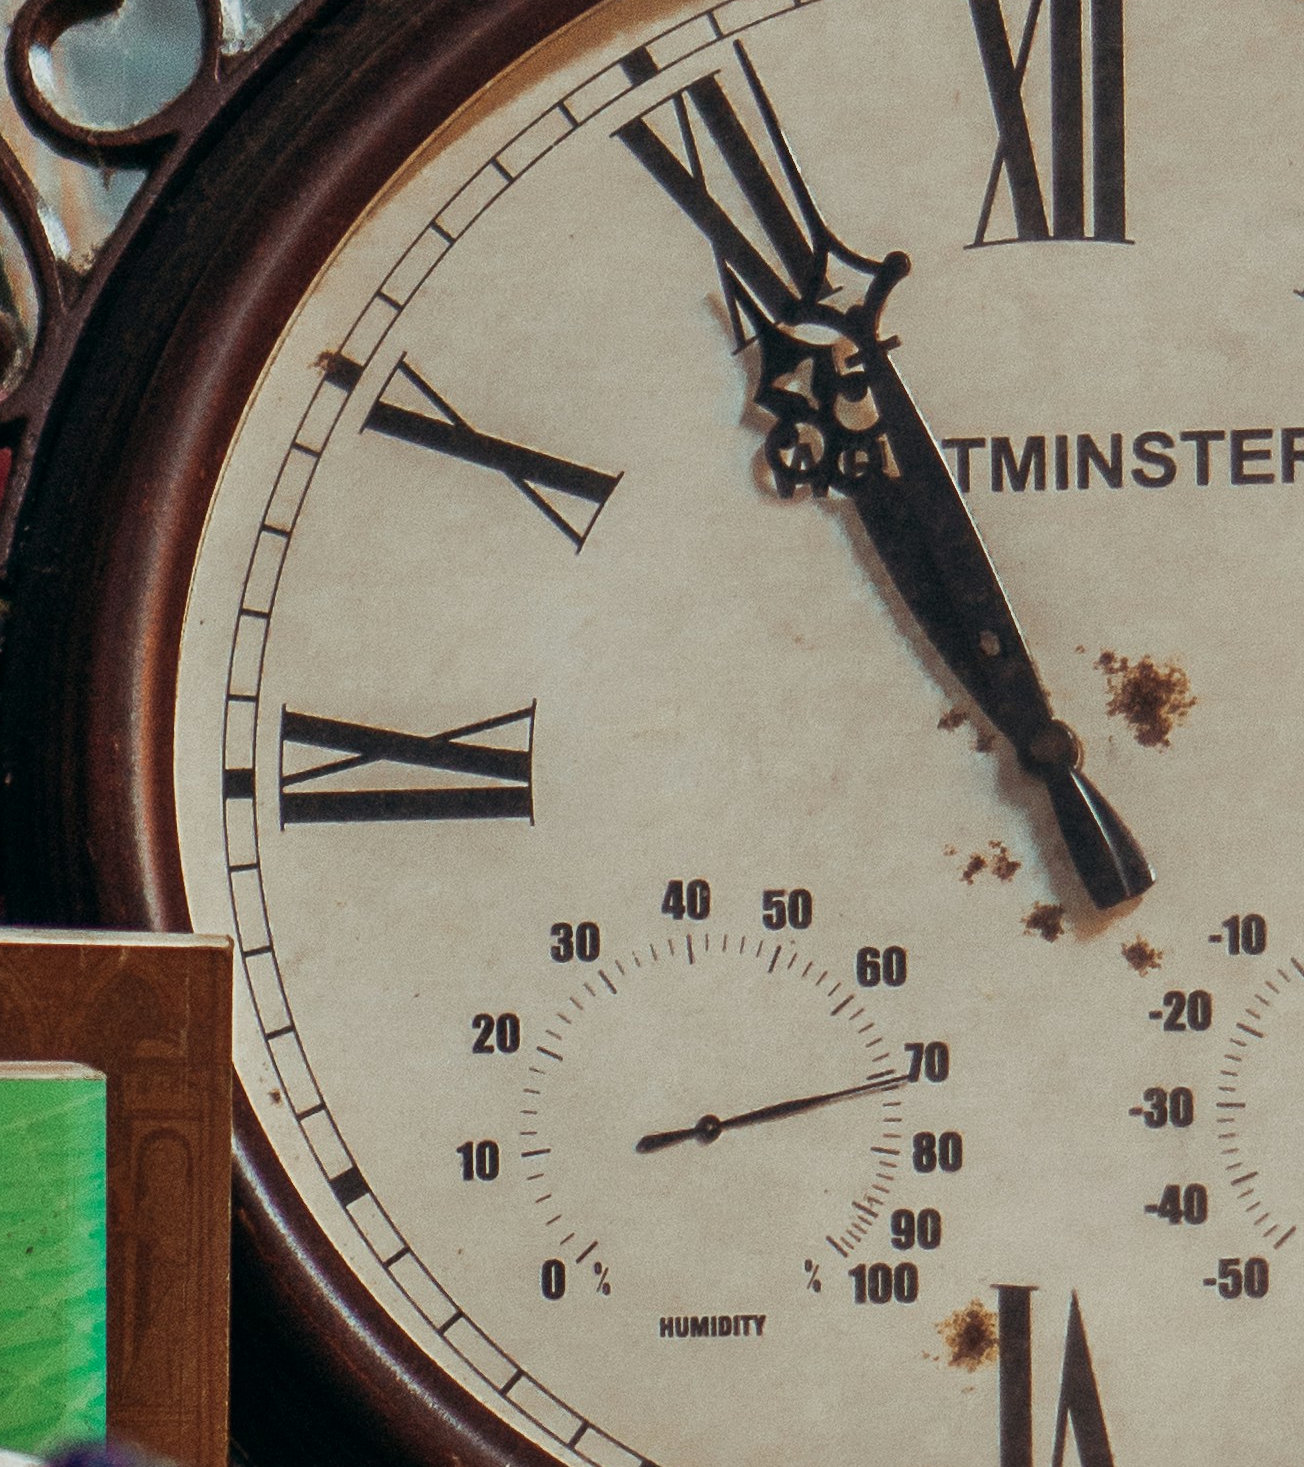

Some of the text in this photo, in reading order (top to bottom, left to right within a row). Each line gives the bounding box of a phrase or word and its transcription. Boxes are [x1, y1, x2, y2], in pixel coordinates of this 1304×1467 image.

[363, 358, 622, 553] X
[280, 701, 536, 826] IX
[661, 878, 711, 920] 40
[762, 888, 812, 930] 50
[550, 922, 600, 962] 30
[1209, 914, 1267, 955] -10
[856, 946, 907, 987] 60
[1149, 989, 1212, 1031] -20
[472, 1012, 520, 1053] 20
[904, 1042, 949, 1082] 70
[1129, 1087, 1194, 1128] -30
[456, 1140, 499, 1181] 10
[912, 1132, 963, 1172] 80
[1144, 1183, 1208, 1224] -40
[891, 1208, 941, 1249] 90
[541, 1259, 565, 1300] 0
[848, 1262, 919, 1304] 100
[1203, 1257, 1269, 1298] -50
[659, 1314, 766, 1337] HUMIDITY
